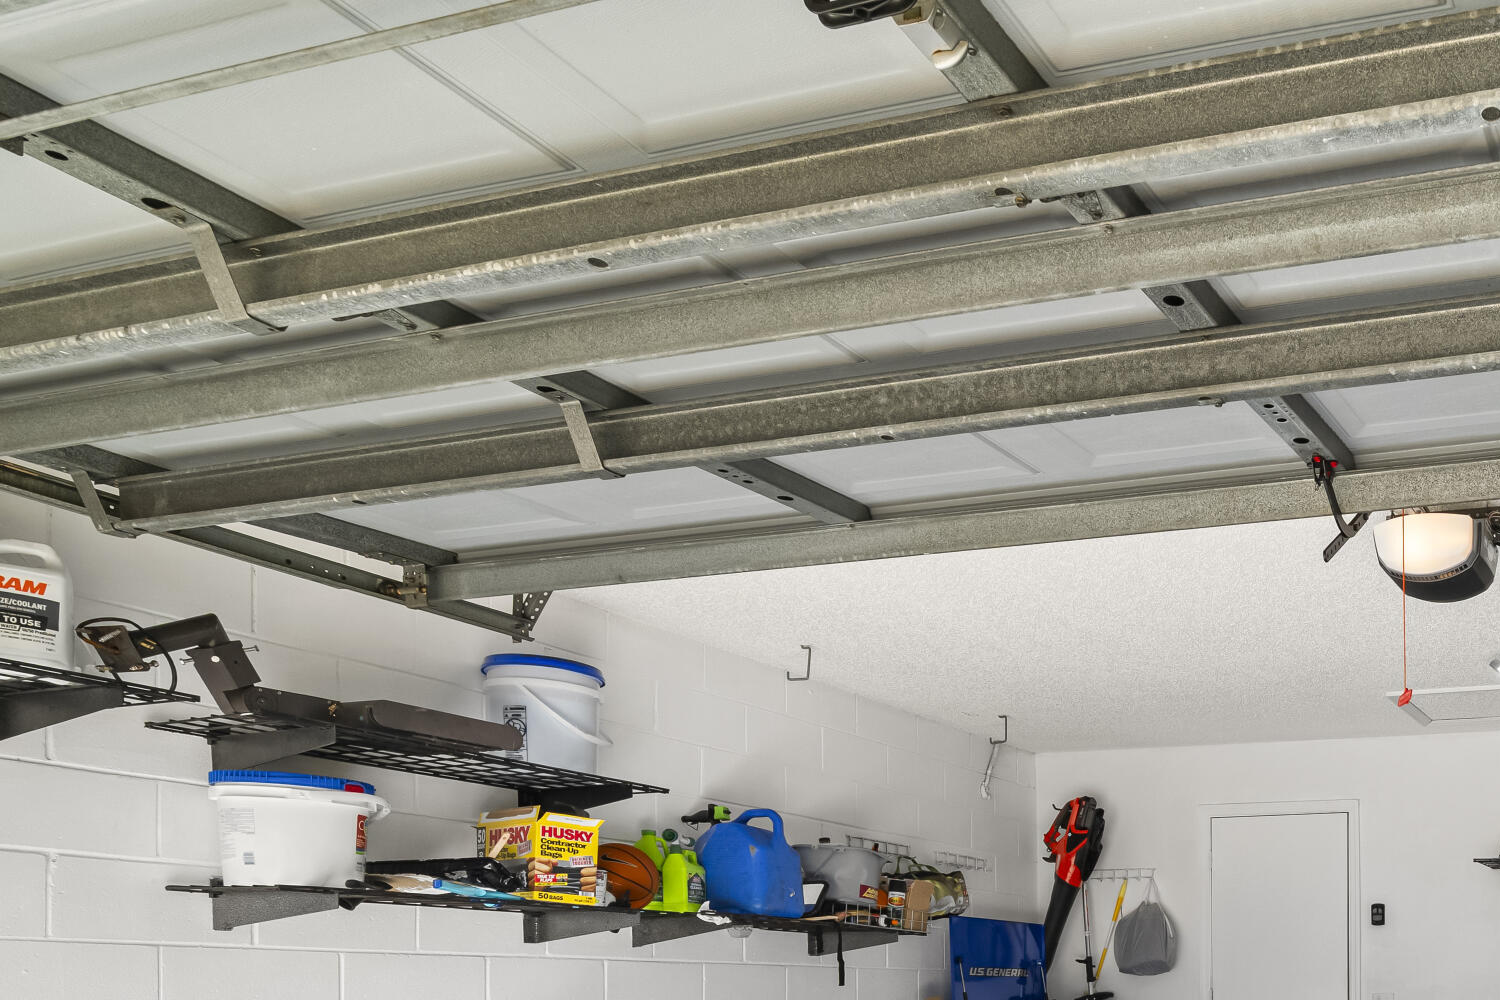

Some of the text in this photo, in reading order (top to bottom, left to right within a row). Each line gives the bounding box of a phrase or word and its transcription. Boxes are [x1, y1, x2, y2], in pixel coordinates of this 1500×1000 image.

[3, 615, 17, 623] TO
[20, 618, 41, 628] USE
[541, 825, 594, 843] HUSKY
[541, 837, 587, 849] Contractor
[540, 850, 563, 859] Bags
[538, 892, 549, 900] 50
[986, 967, 1028, 977] GENERAL
